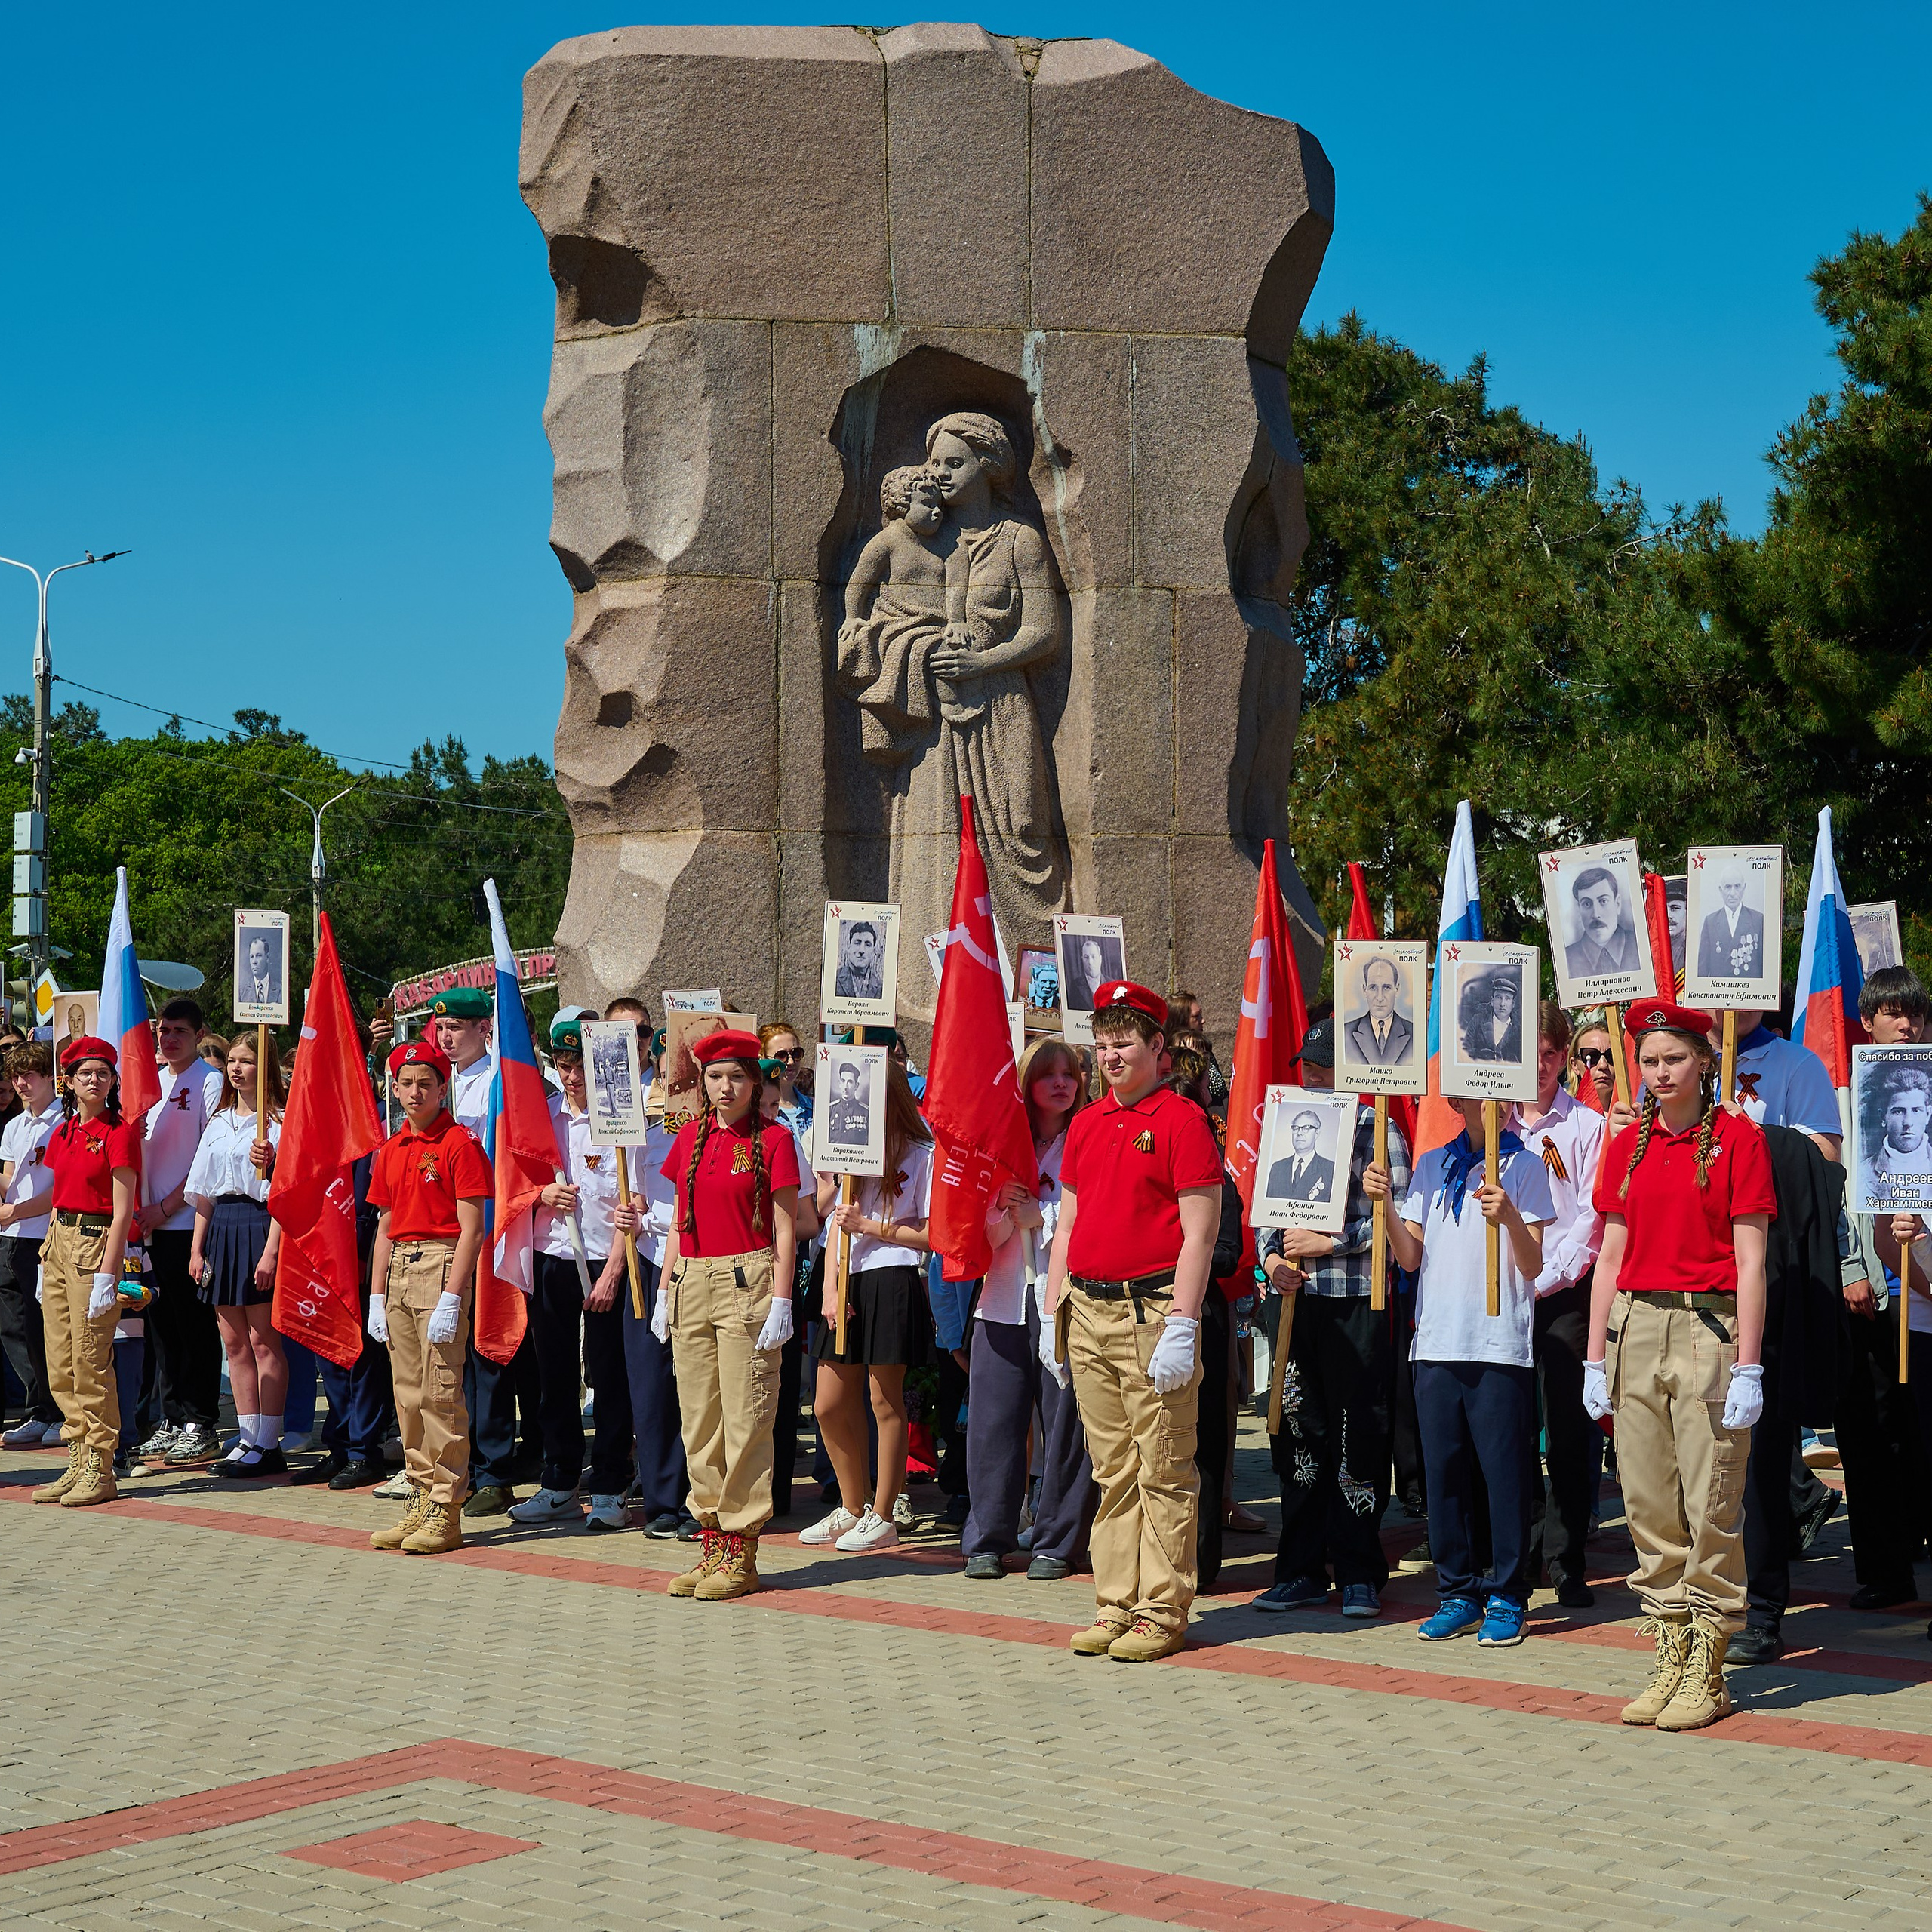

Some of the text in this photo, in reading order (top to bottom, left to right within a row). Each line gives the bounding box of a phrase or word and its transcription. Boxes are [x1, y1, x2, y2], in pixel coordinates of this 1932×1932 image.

[1608, 856, 1628, 864] ПОЛК
[394, 954, 558, 1011] КАБАРДИН ПР
[1585, 976, 1631, 987] Илларионов
[1710, 980, 1750, 989] Кимишкез
[1577, 986, 1642, 998] Петр Алексеевич
[1687, 991, 1777, 1001] Константин Ефимович
[1858, 1051, 1901, 1061] Спасибо
[1903, 1052, 1914, 1061] за
[1369, 1066, 1393, 1075] Мацко
[1473, 1069, 1505, 1079] Андреев
[1346, 1076, 1417, 1087] Григорий Петрович
[1465, 1079, 1514, 1089] Федор Ильич
[819, 1155, 878, 1165] Анатолий Петрович
[1891, 1186, 1920, 1198] Иван
[1285, 1201, 1315, 1210] Афонин
[1289, 1211, 1329, 1220] Федорович
